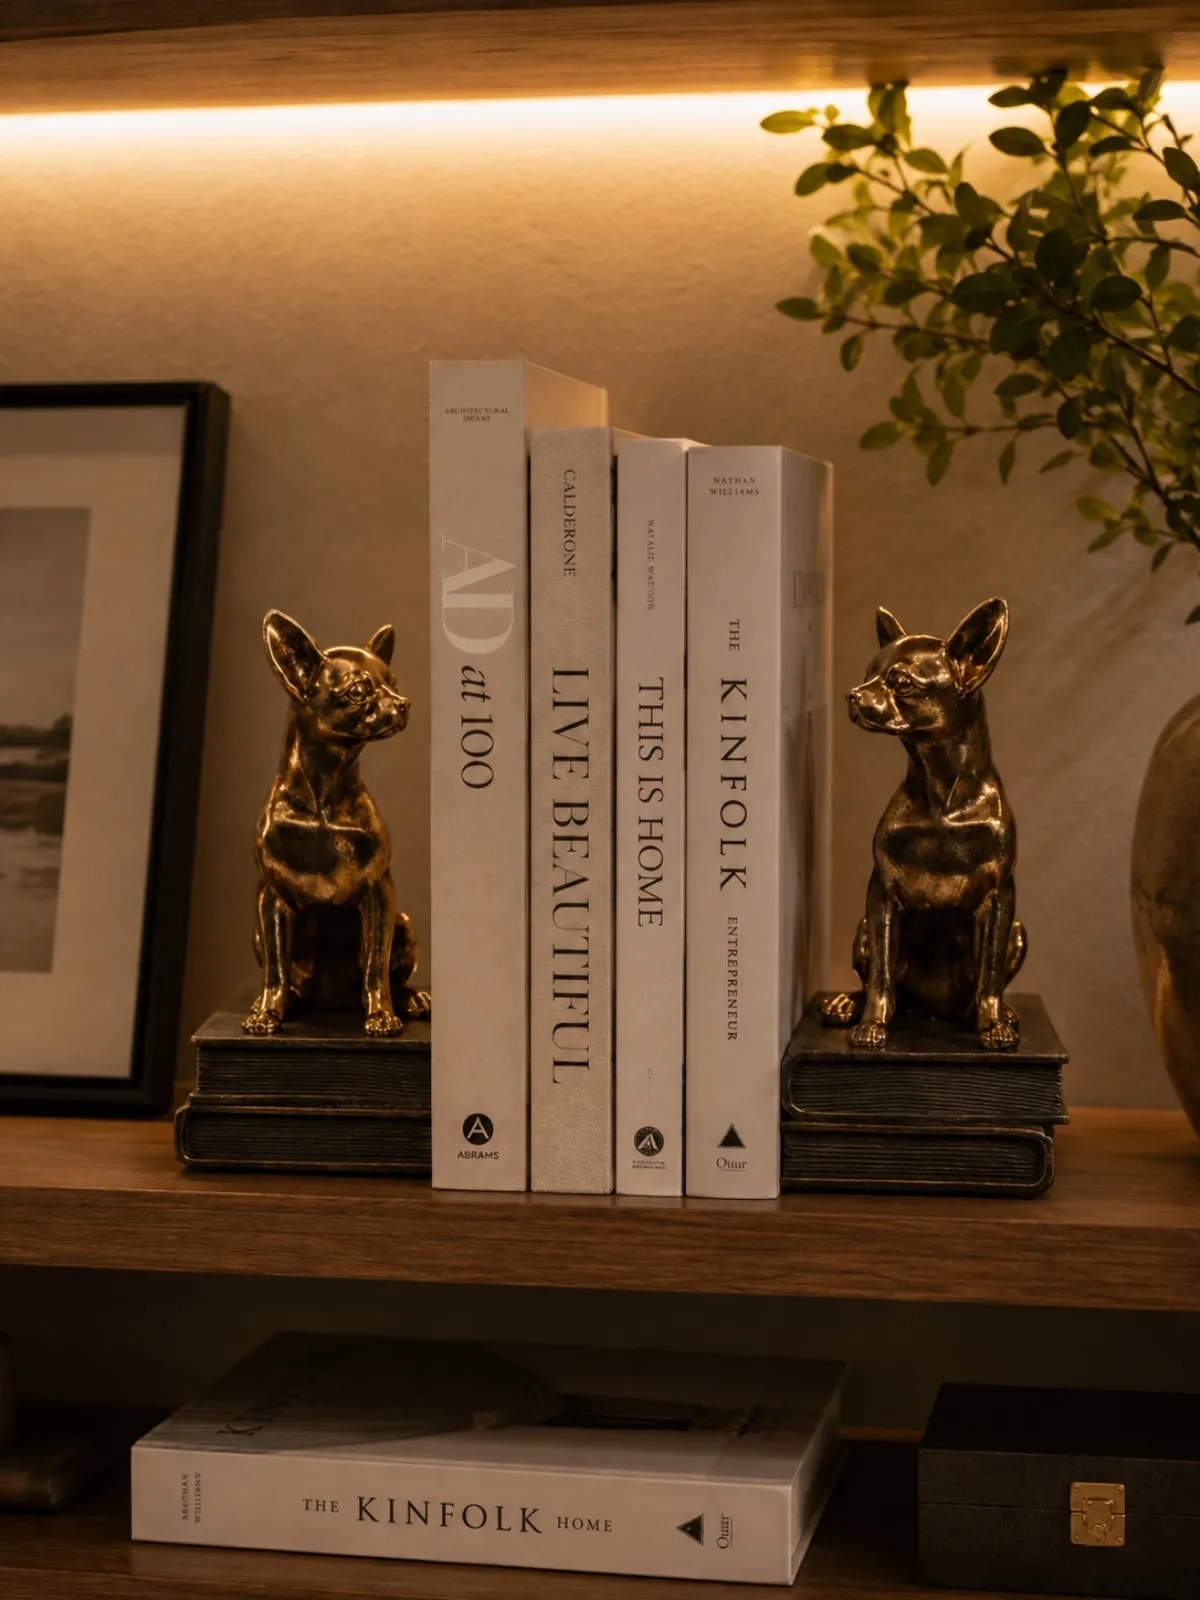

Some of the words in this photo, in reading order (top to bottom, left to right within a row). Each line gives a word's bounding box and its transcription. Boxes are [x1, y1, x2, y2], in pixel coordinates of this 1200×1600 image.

[709, 487, 761, 496] WILLIAMS
[713, 476, 757, 485] NATHAN
[563, 468, 577, 578] CALDERONE
[441, 530, 516, 656] AD
[728, 618, 740, 651] THE
[460, 665, 492, 703] at
[552, 667, 590, 780] LIVE
[637, 676, 664, 762] THIS
[460, 714, 496, 790] 100
[637, 775, 664, 804] IS
[719, 678, 748, 891] KINFOLK
[637, 815, 664, 928] HOME
[552, 798, 590, 1084] BEAUTIFUL
[727, 916, 739, 1041] ENTREPRENEUR
[457, 1150, 499, 1160] ABRAMS
[302, 1497, 340, 1514] THE
[357, 1496, 543, 1534] KINFOLK
[556, 1515, 614, 1534] HOME
